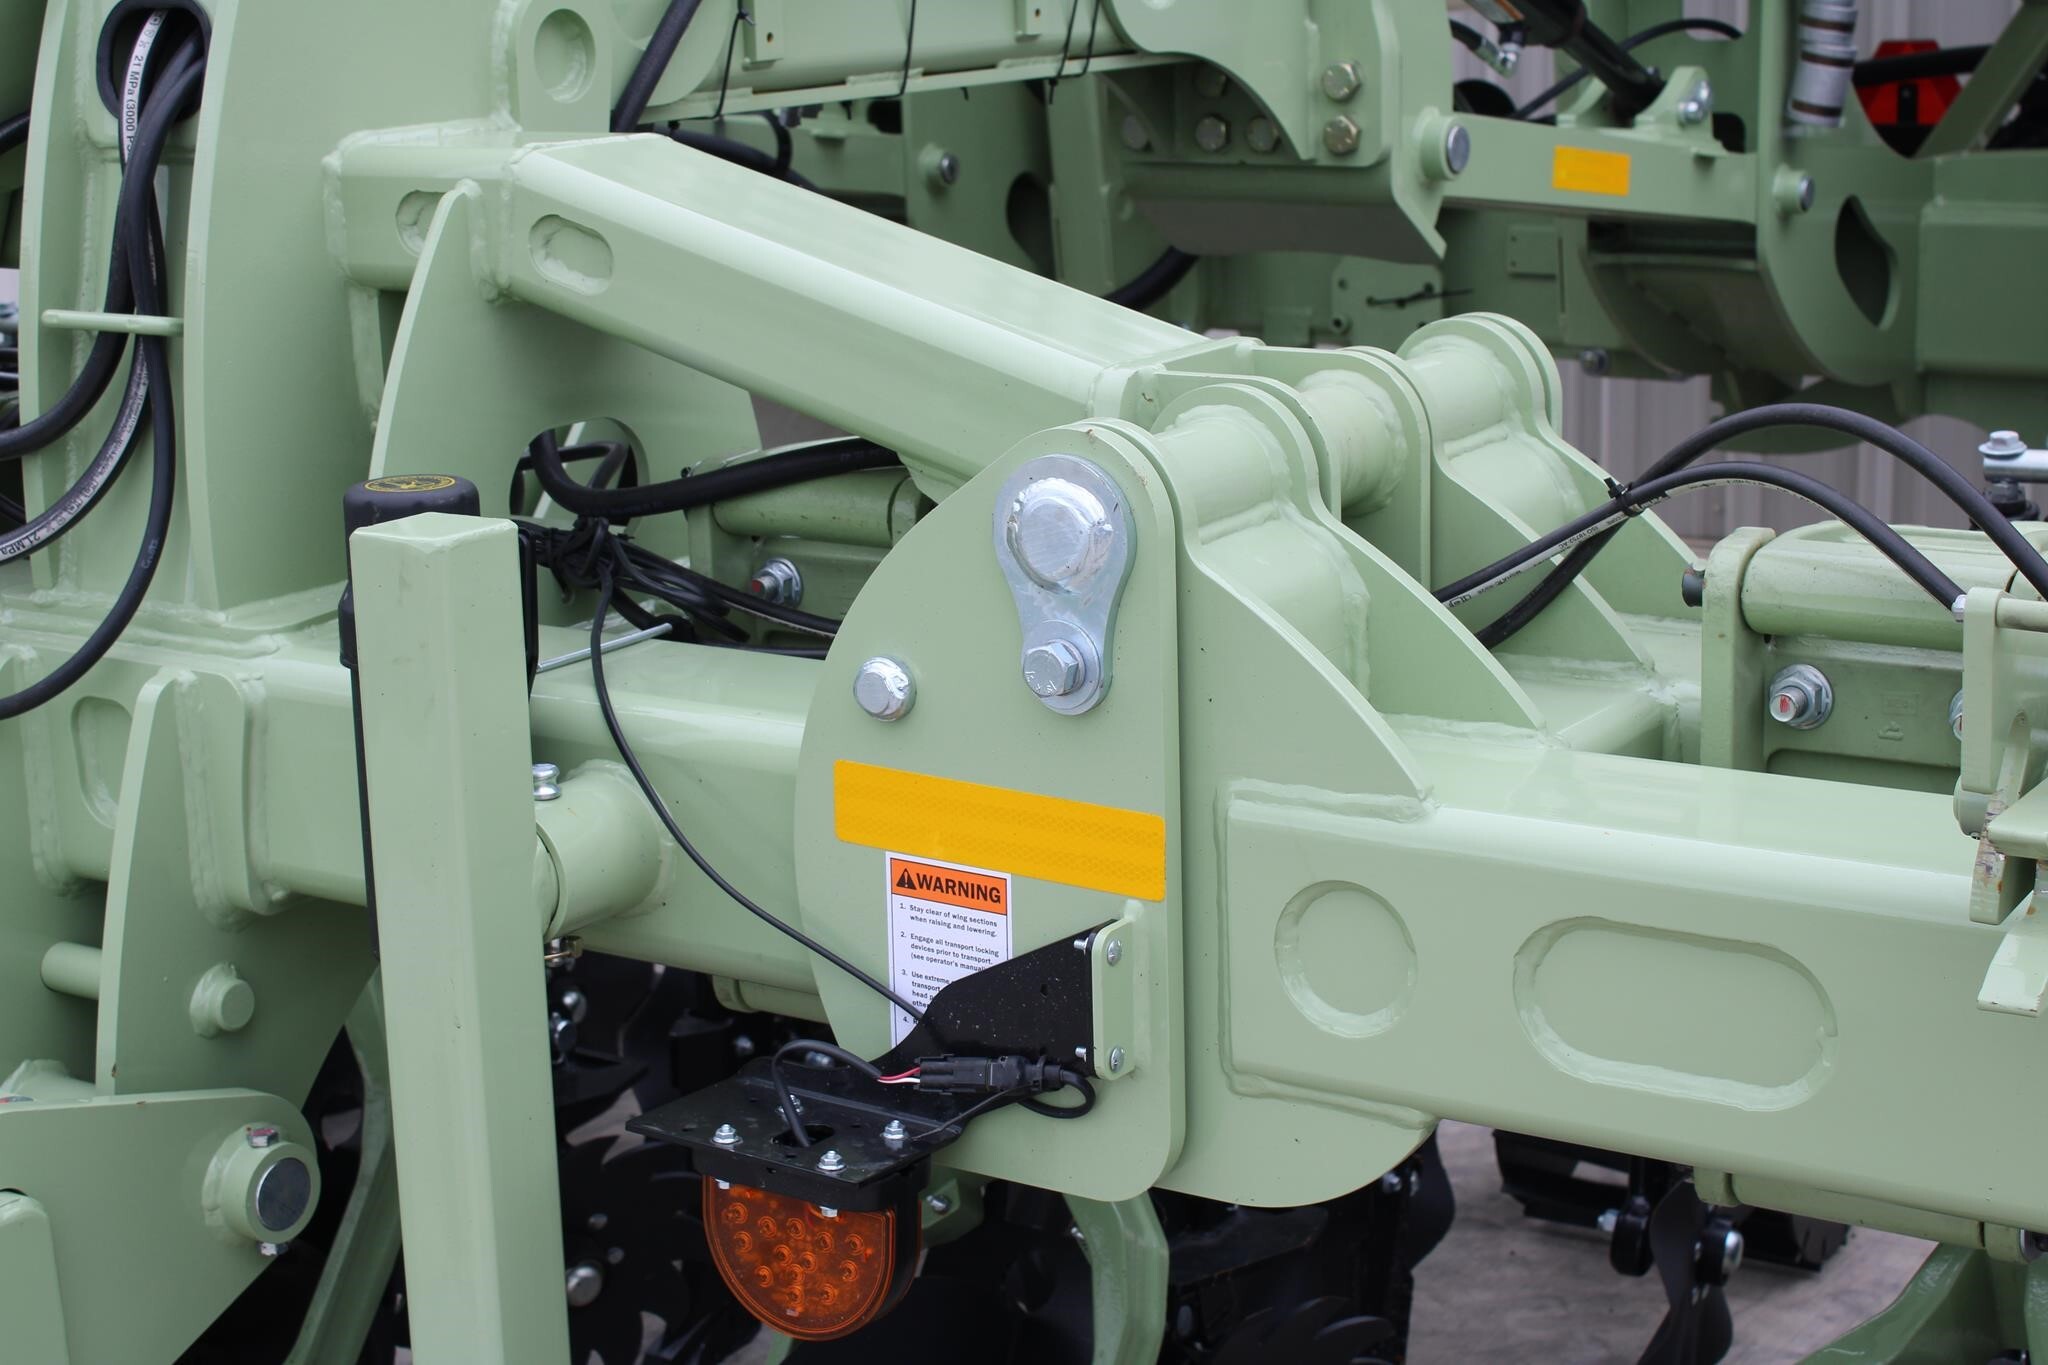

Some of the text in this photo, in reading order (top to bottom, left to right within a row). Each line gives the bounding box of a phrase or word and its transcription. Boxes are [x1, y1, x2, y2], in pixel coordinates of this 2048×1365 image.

[134, 55, 143, 68] 21
[127, 71, 140, 95] MPa
[125, 98, 137, 132] (3000
[0, 531, 40, 555] 21 MPa
[916, 872, 1001, 905] WARNING
[899, 902, 906, 910] 1.
[909, 904, 924, 914] Stay
[925, 907, 942, 917] clear
[952, 913, 968, 923] wing
[969, 916, 998, 928] sections
[909, 914, 928, 923] when
[928, 918, 952, 929] raising
[953, 923, 966, 931] and
[910, 932, 934, 944] Engage
[935, 938, 944, 946] all
[944, 940, 974, 952] transport
[975, 946, 1000, 958] locking
[910, 942, 993, 965] devices prior to transport.
[910, 952, 925, 961] (see
[925, 955, 959, 968] operator's
[901, 968, 950, 985] 3. Use extreme
[911, 989, 928, 999] head
[903, 1016, 910, 1024] 4.
